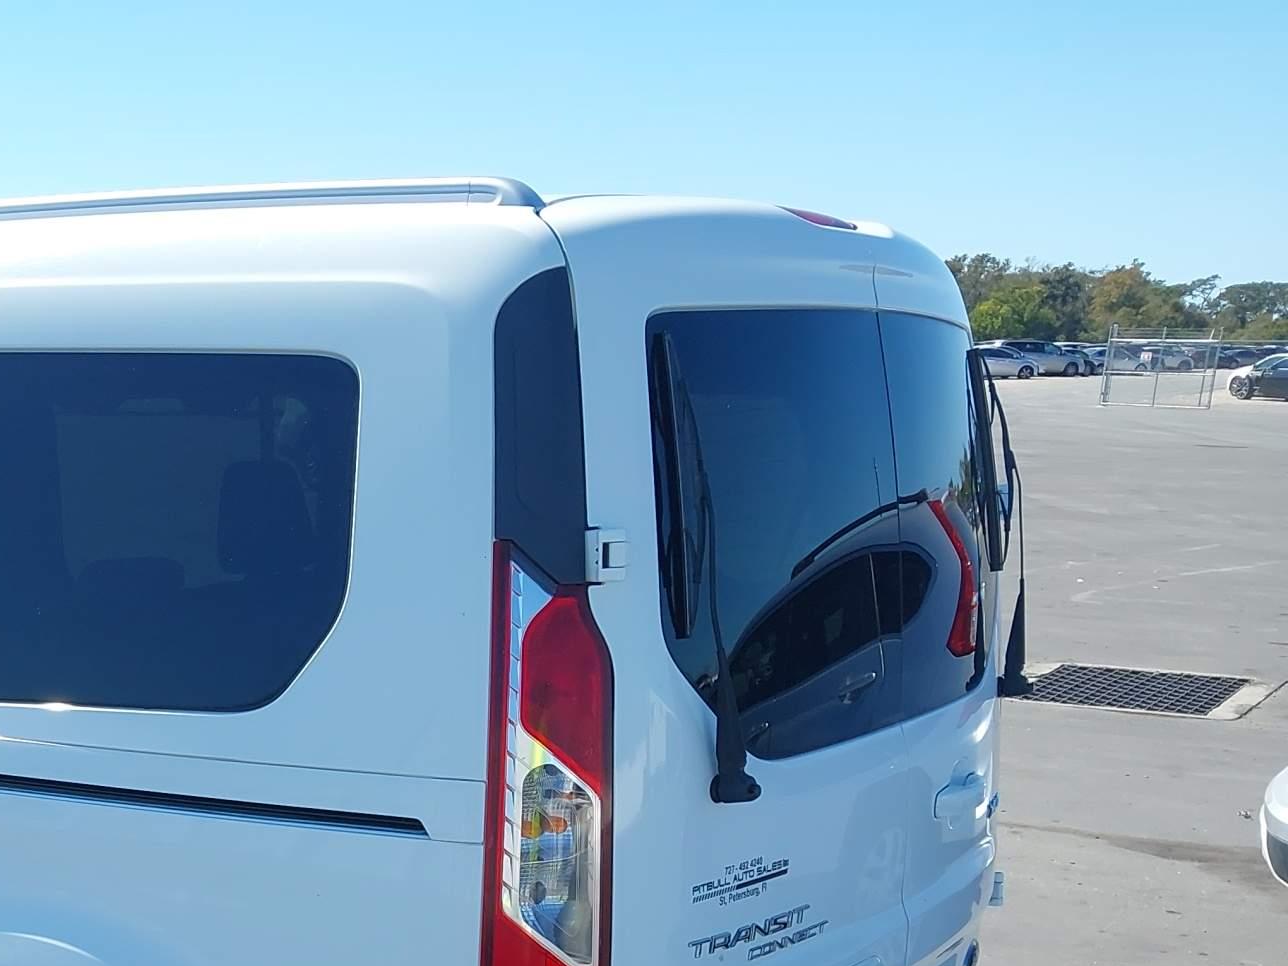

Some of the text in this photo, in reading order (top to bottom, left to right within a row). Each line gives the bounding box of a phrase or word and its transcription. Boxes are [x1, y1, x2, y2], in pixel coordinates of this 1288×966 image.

[732, 869, 755, 883] AUTO
[688, 904, 810, 958] TRANSIT
[748, 920, 829, 960] CONNECT
